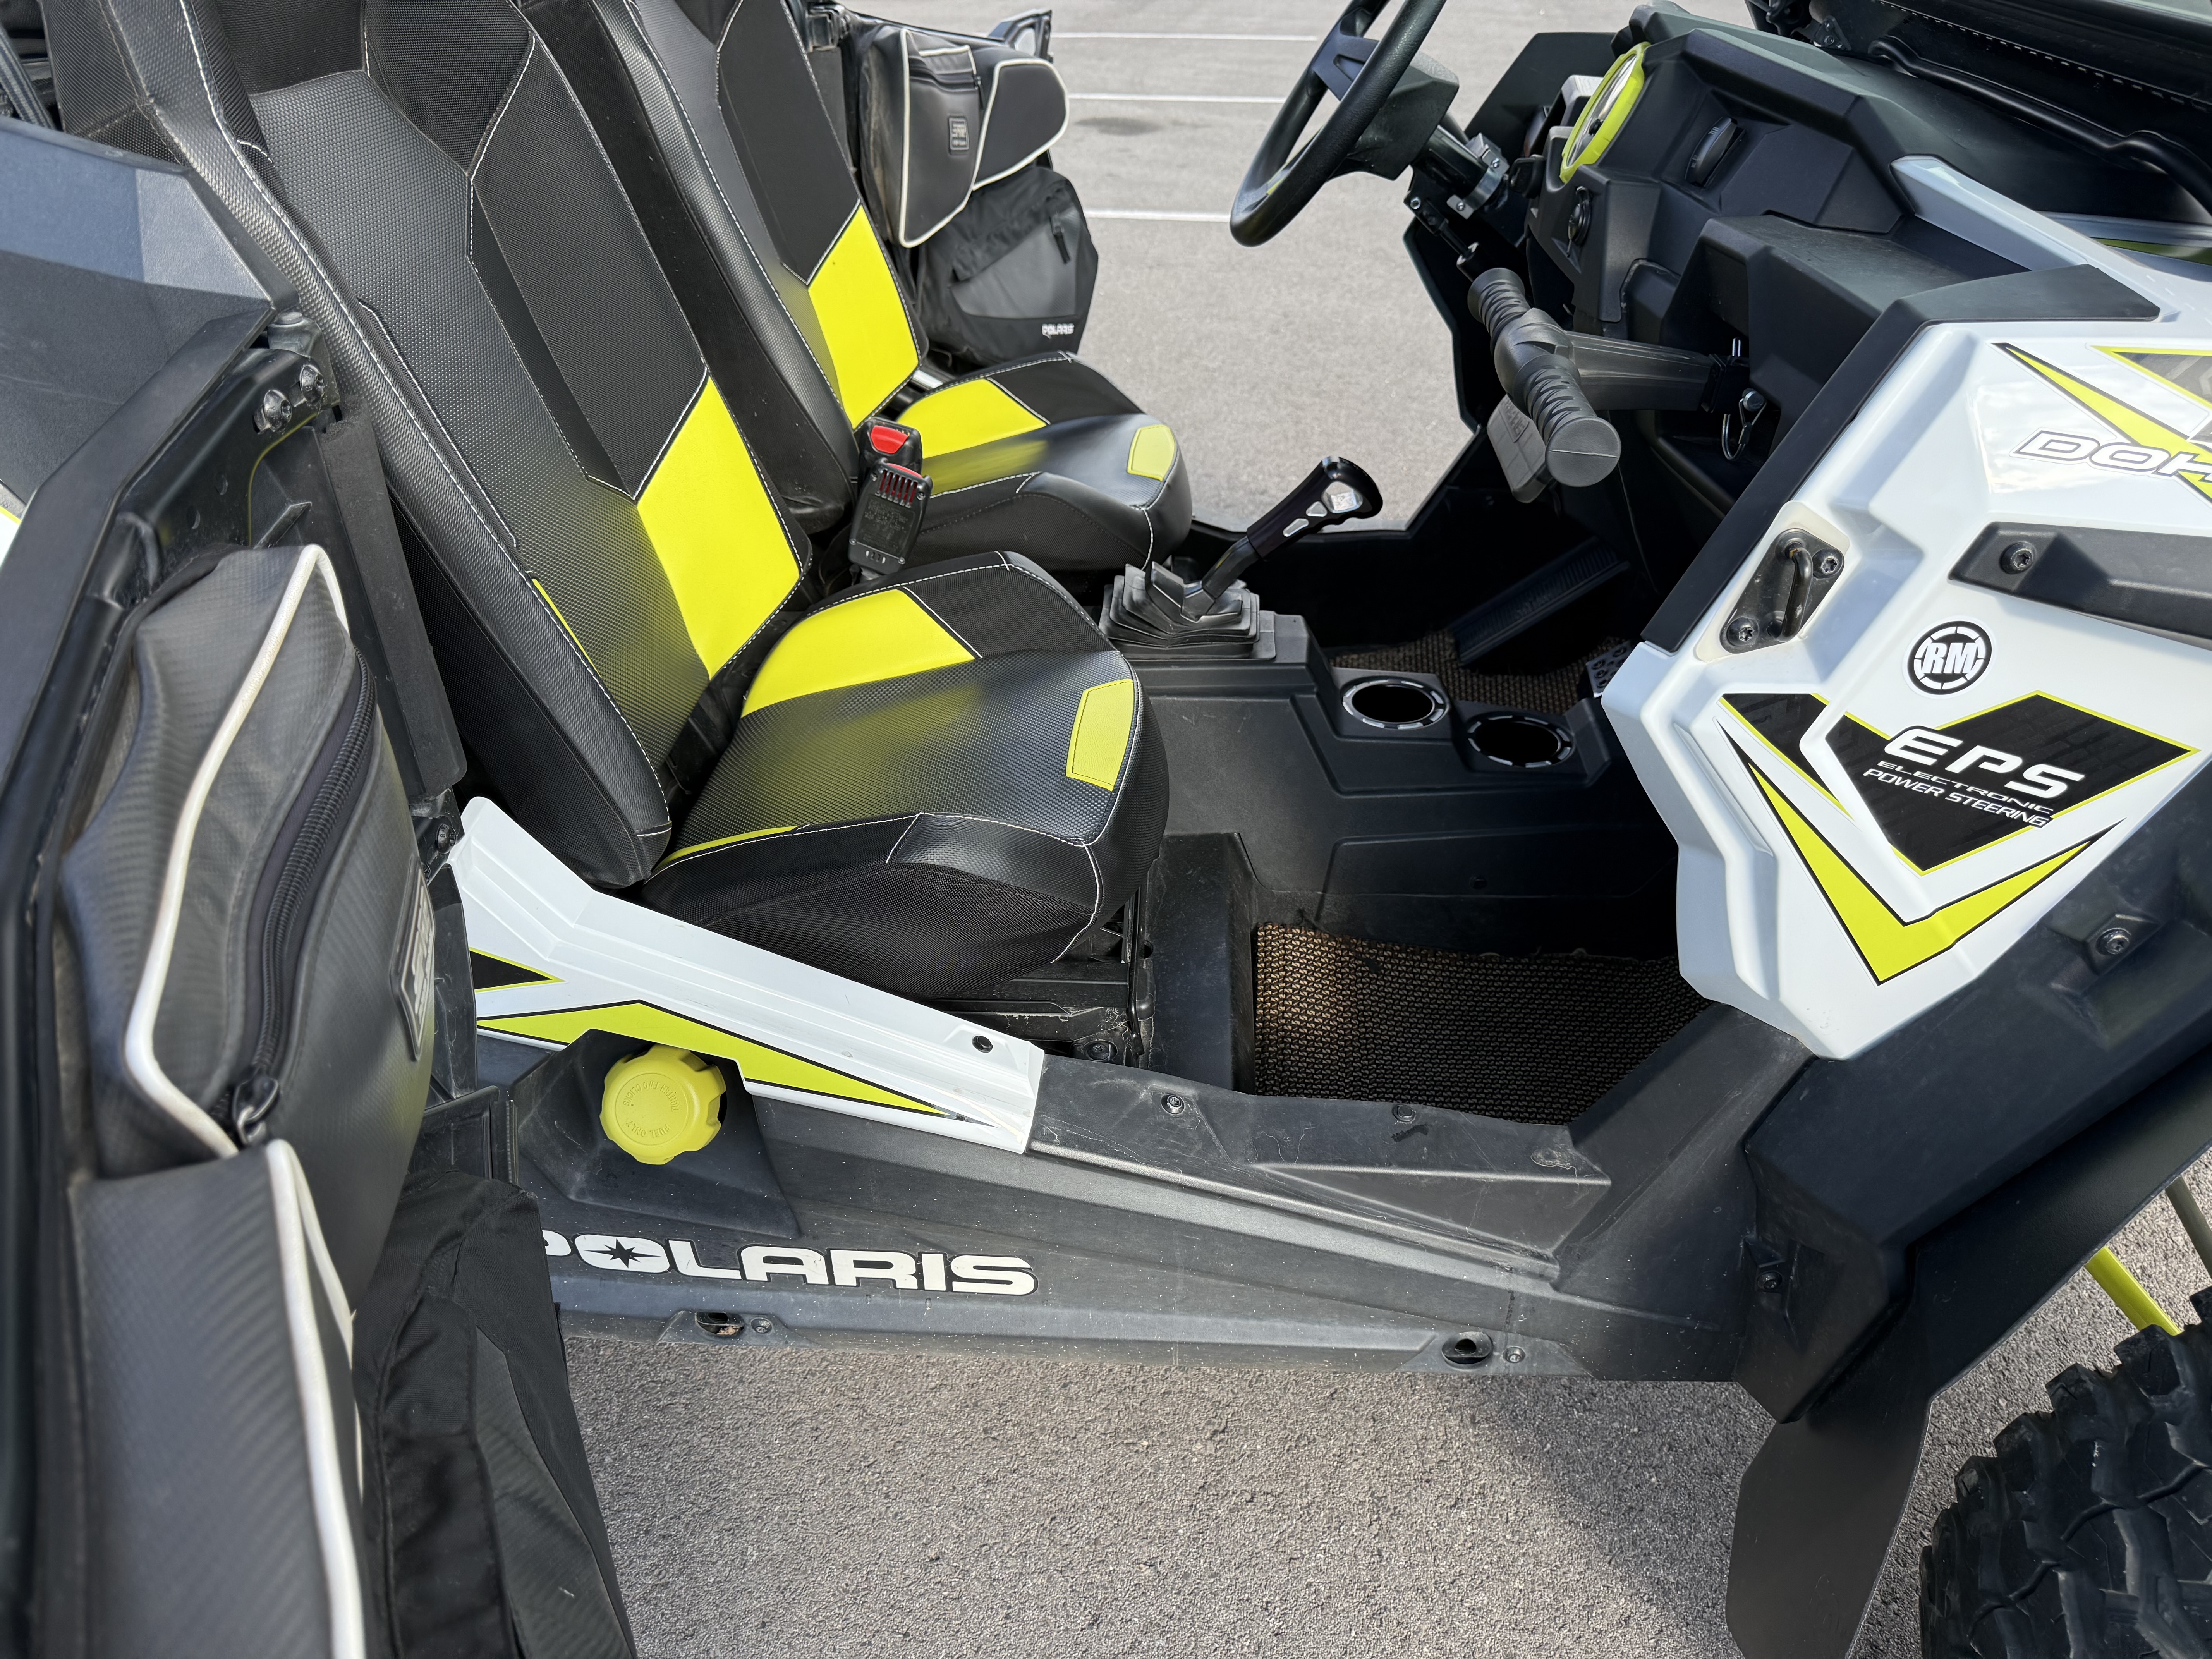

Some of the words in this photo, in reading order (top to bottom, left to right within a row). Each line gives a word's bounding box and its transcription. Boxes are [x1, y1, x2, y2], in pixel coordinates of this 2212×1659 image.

[1922, 642, 1977, 674] RM
[1884, 728, 2085, 799] EPS
[1863, 768, 1945, 797] POWER
[1945, 792, 2051, 826] STEERING
[1877, 761, 2054, 814] ELECTRONIC
[625, 1121, 646, 1137] ONLY
[649, 1124, 670, 1139] FUEL
